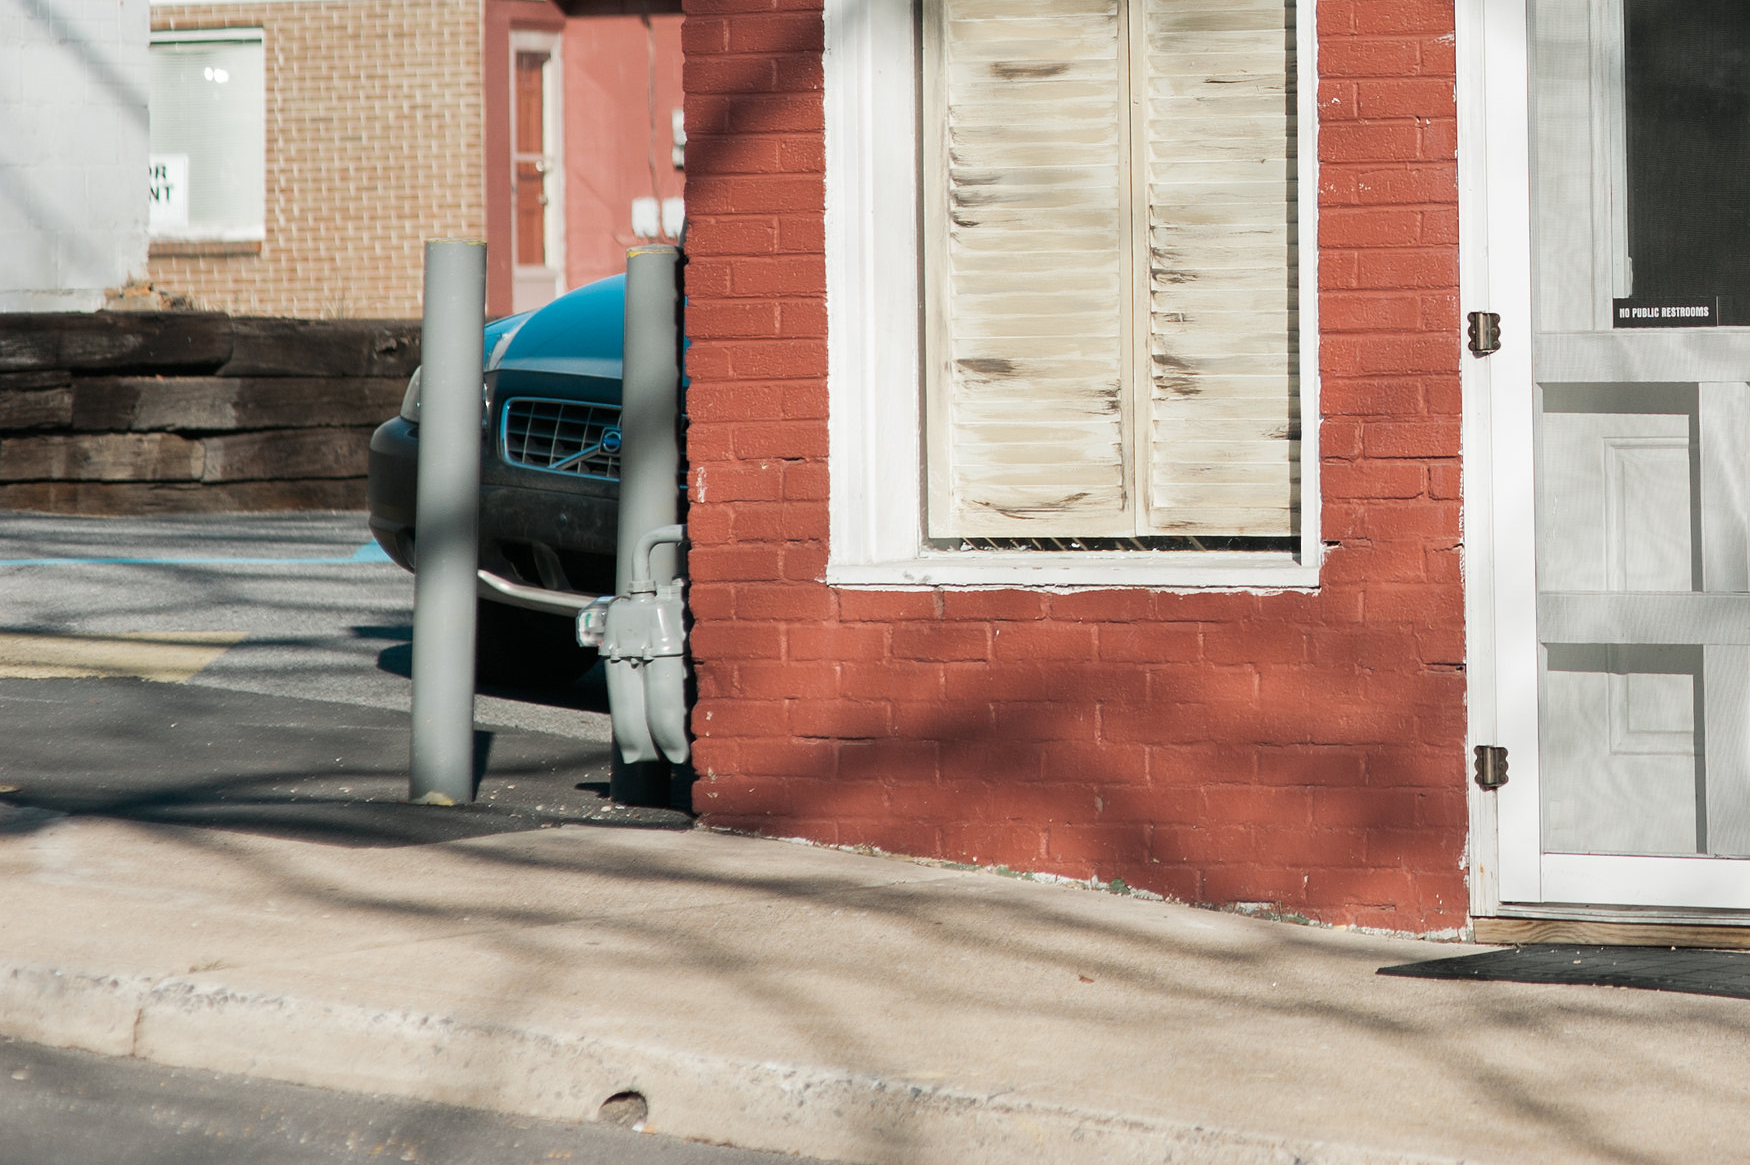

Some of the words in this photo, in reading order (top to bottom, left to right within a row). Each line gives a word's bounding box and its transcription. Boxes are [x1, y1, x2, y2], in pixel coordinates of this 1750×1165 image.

[1619, 307, 1630, 318] NO
[1632, 307, 1660, 318] PUBLIC
[1661, 306, 1709, 318] RESTROOMS
